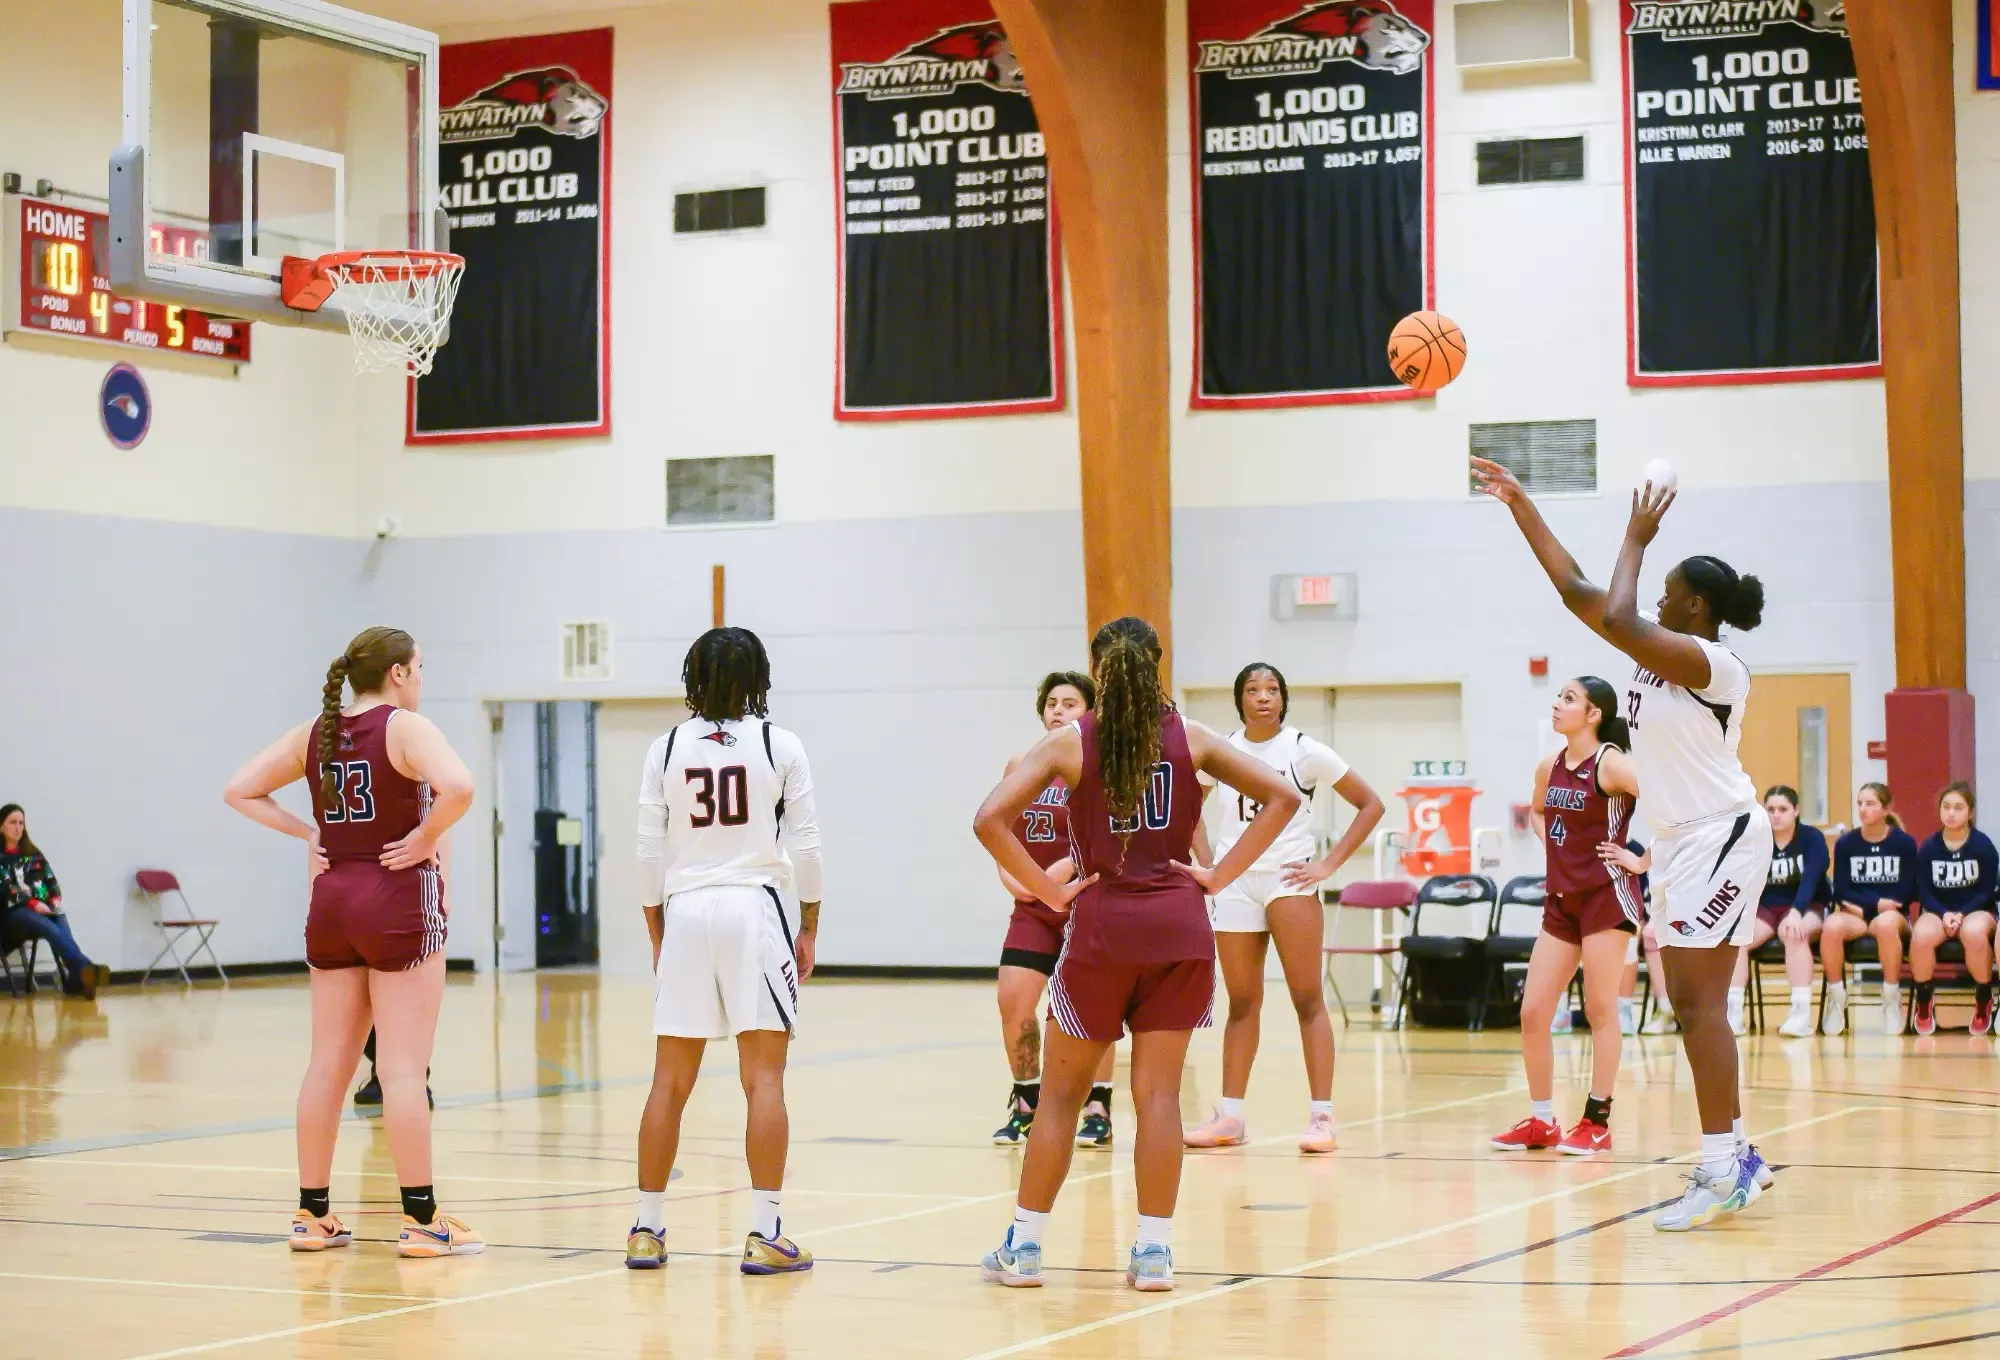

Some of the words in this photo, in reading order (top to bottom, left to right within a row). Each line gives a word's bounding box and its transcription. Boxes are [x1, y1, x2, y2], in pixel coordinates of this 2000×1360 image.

[1692, 48, 1809, 85] 1,000
[1255, 84, 1366, 120] 1,000
[1637, 85, 1761, 118] POINT
[892, 105, 996, 140] 1,000
[1205, 117, 1347, 153] REBOUNDS
[1351, 110, 1419, 143] CLUB
[1638, 124, 1699, 142] KRISTINA
[1702, 122, 1745, 138] CLARK
[1766, 115, 1824, 135] 2013-17
[1832, 113, 1864, 130] 1,77
[460, 146, 552, 181] 1,000
[845, 138, 954, 172] POINT
[958, 131, 1046, 164] CLUB
[1323, 150, 1379, 169] 2013-17
[1639, 145, 1675, 164] ALLIE
[1677, 143, 1731, 160] WARREN
[1766, 137, 1825, 156] 2016-20
[498, 172, 579, 204] CLUB
[27, 207, 86, 241] HOME
[47, 242, 78, 295] 10
[91, 291, 107, 334] 4
[166, 305, 184, 347] 5
[1627, 689, 1642, 730] 32
[685, 764, 749, 828] 30
[1110, 762, 1172, 833] 0
[1545, 786, 1587, 811] EVILS
[1023, 810, 1055, 842] 23
[1550, 814, 1567, 846] 4
[1850, 856, 1900, 877] FDU
[1932, 859, 1979, 883] FDU
[1695, 879, 1741, 930] LIONS
